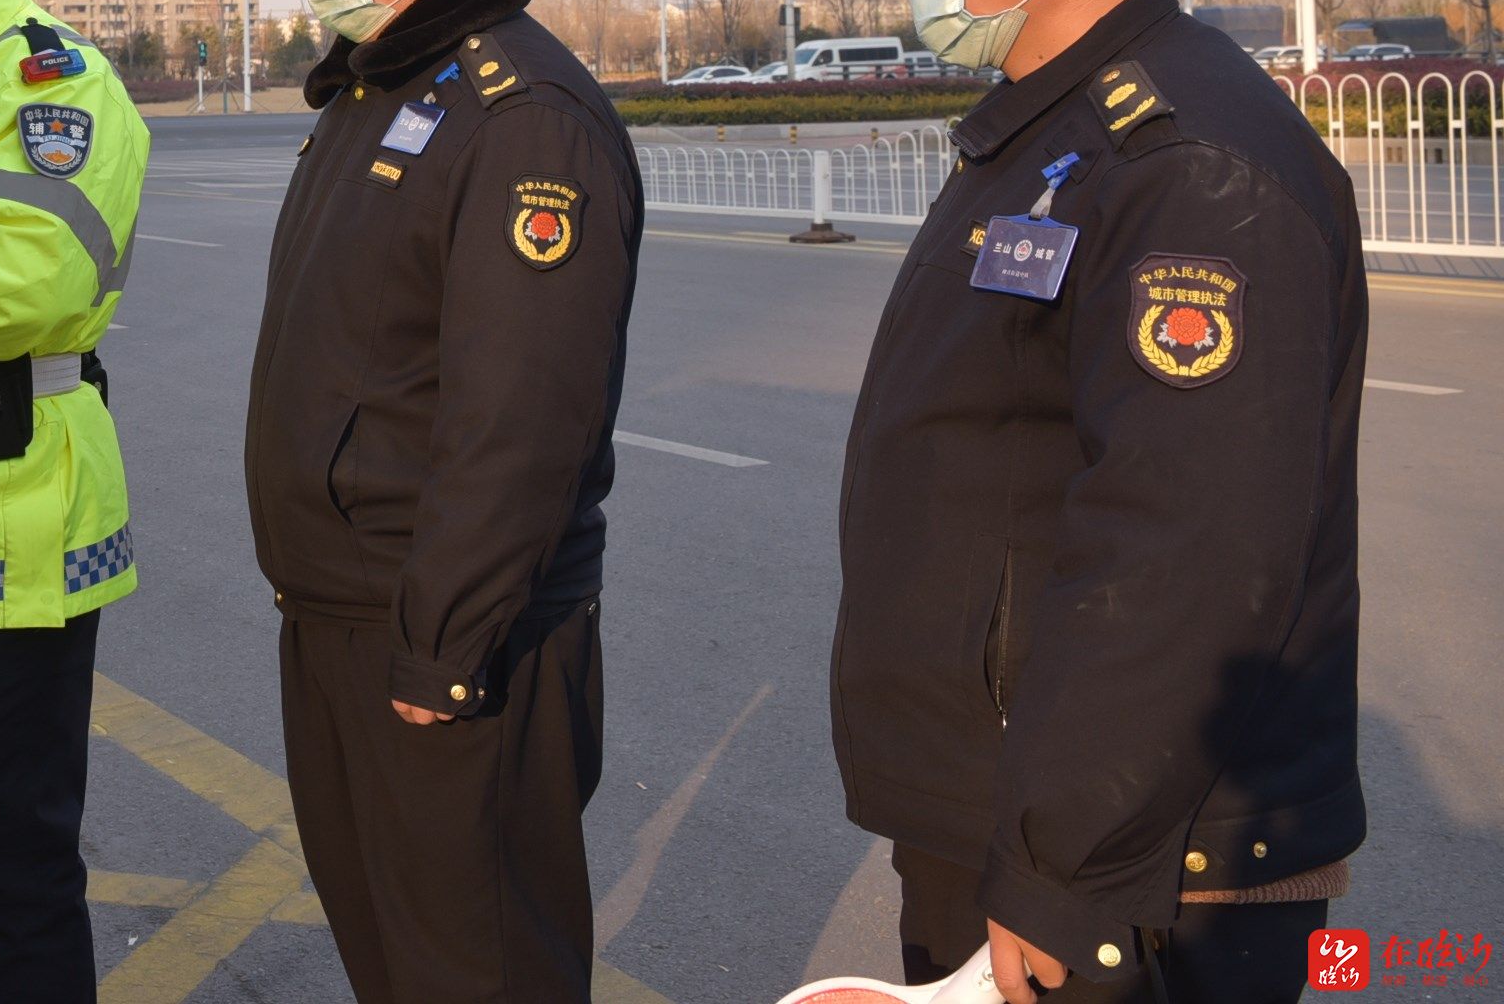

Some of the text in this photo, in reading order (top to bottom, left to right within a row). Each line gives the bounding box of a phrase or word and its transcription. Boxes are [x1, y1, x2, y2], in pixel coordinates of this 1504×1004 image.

[42, 56, 69, 66] POLICE
[24, 108, 89, 128] 中华人民共和国
[516, 181, 578, 201] 中华人民共和国
[521, 194, 570, 210] 城市管理执法
[992, 242, 1012, 254] 兰山
[1034, 247, 1056, 261] 城管
[1138, 266, 1238, 294] 中华人民共和国
[1148, 286, 1228, 307] 城市管理执法
